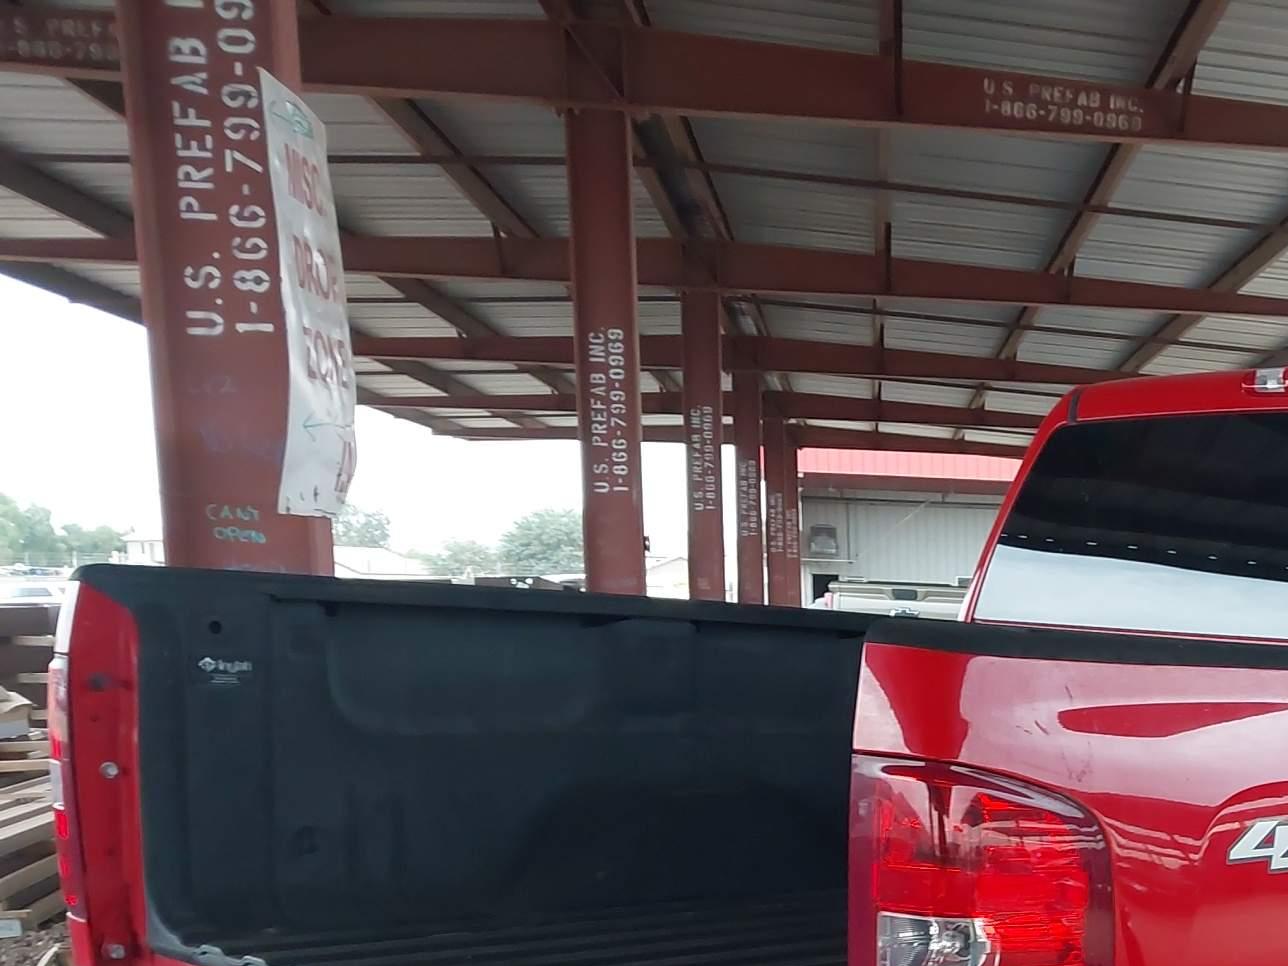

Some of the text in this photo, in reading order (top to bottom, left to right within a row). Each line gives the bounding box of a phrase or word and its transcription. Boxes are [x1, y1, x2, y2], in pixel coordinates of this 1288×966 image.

[168, 37, 218, 221] PREFAB
[1029, 83, 1101, 108] PREFAB
[184, 251, 224, 336] U.S.
[590, 373, 608, 447] PREFAB
[607, 328, 629, 492] 1-866-799-0969
